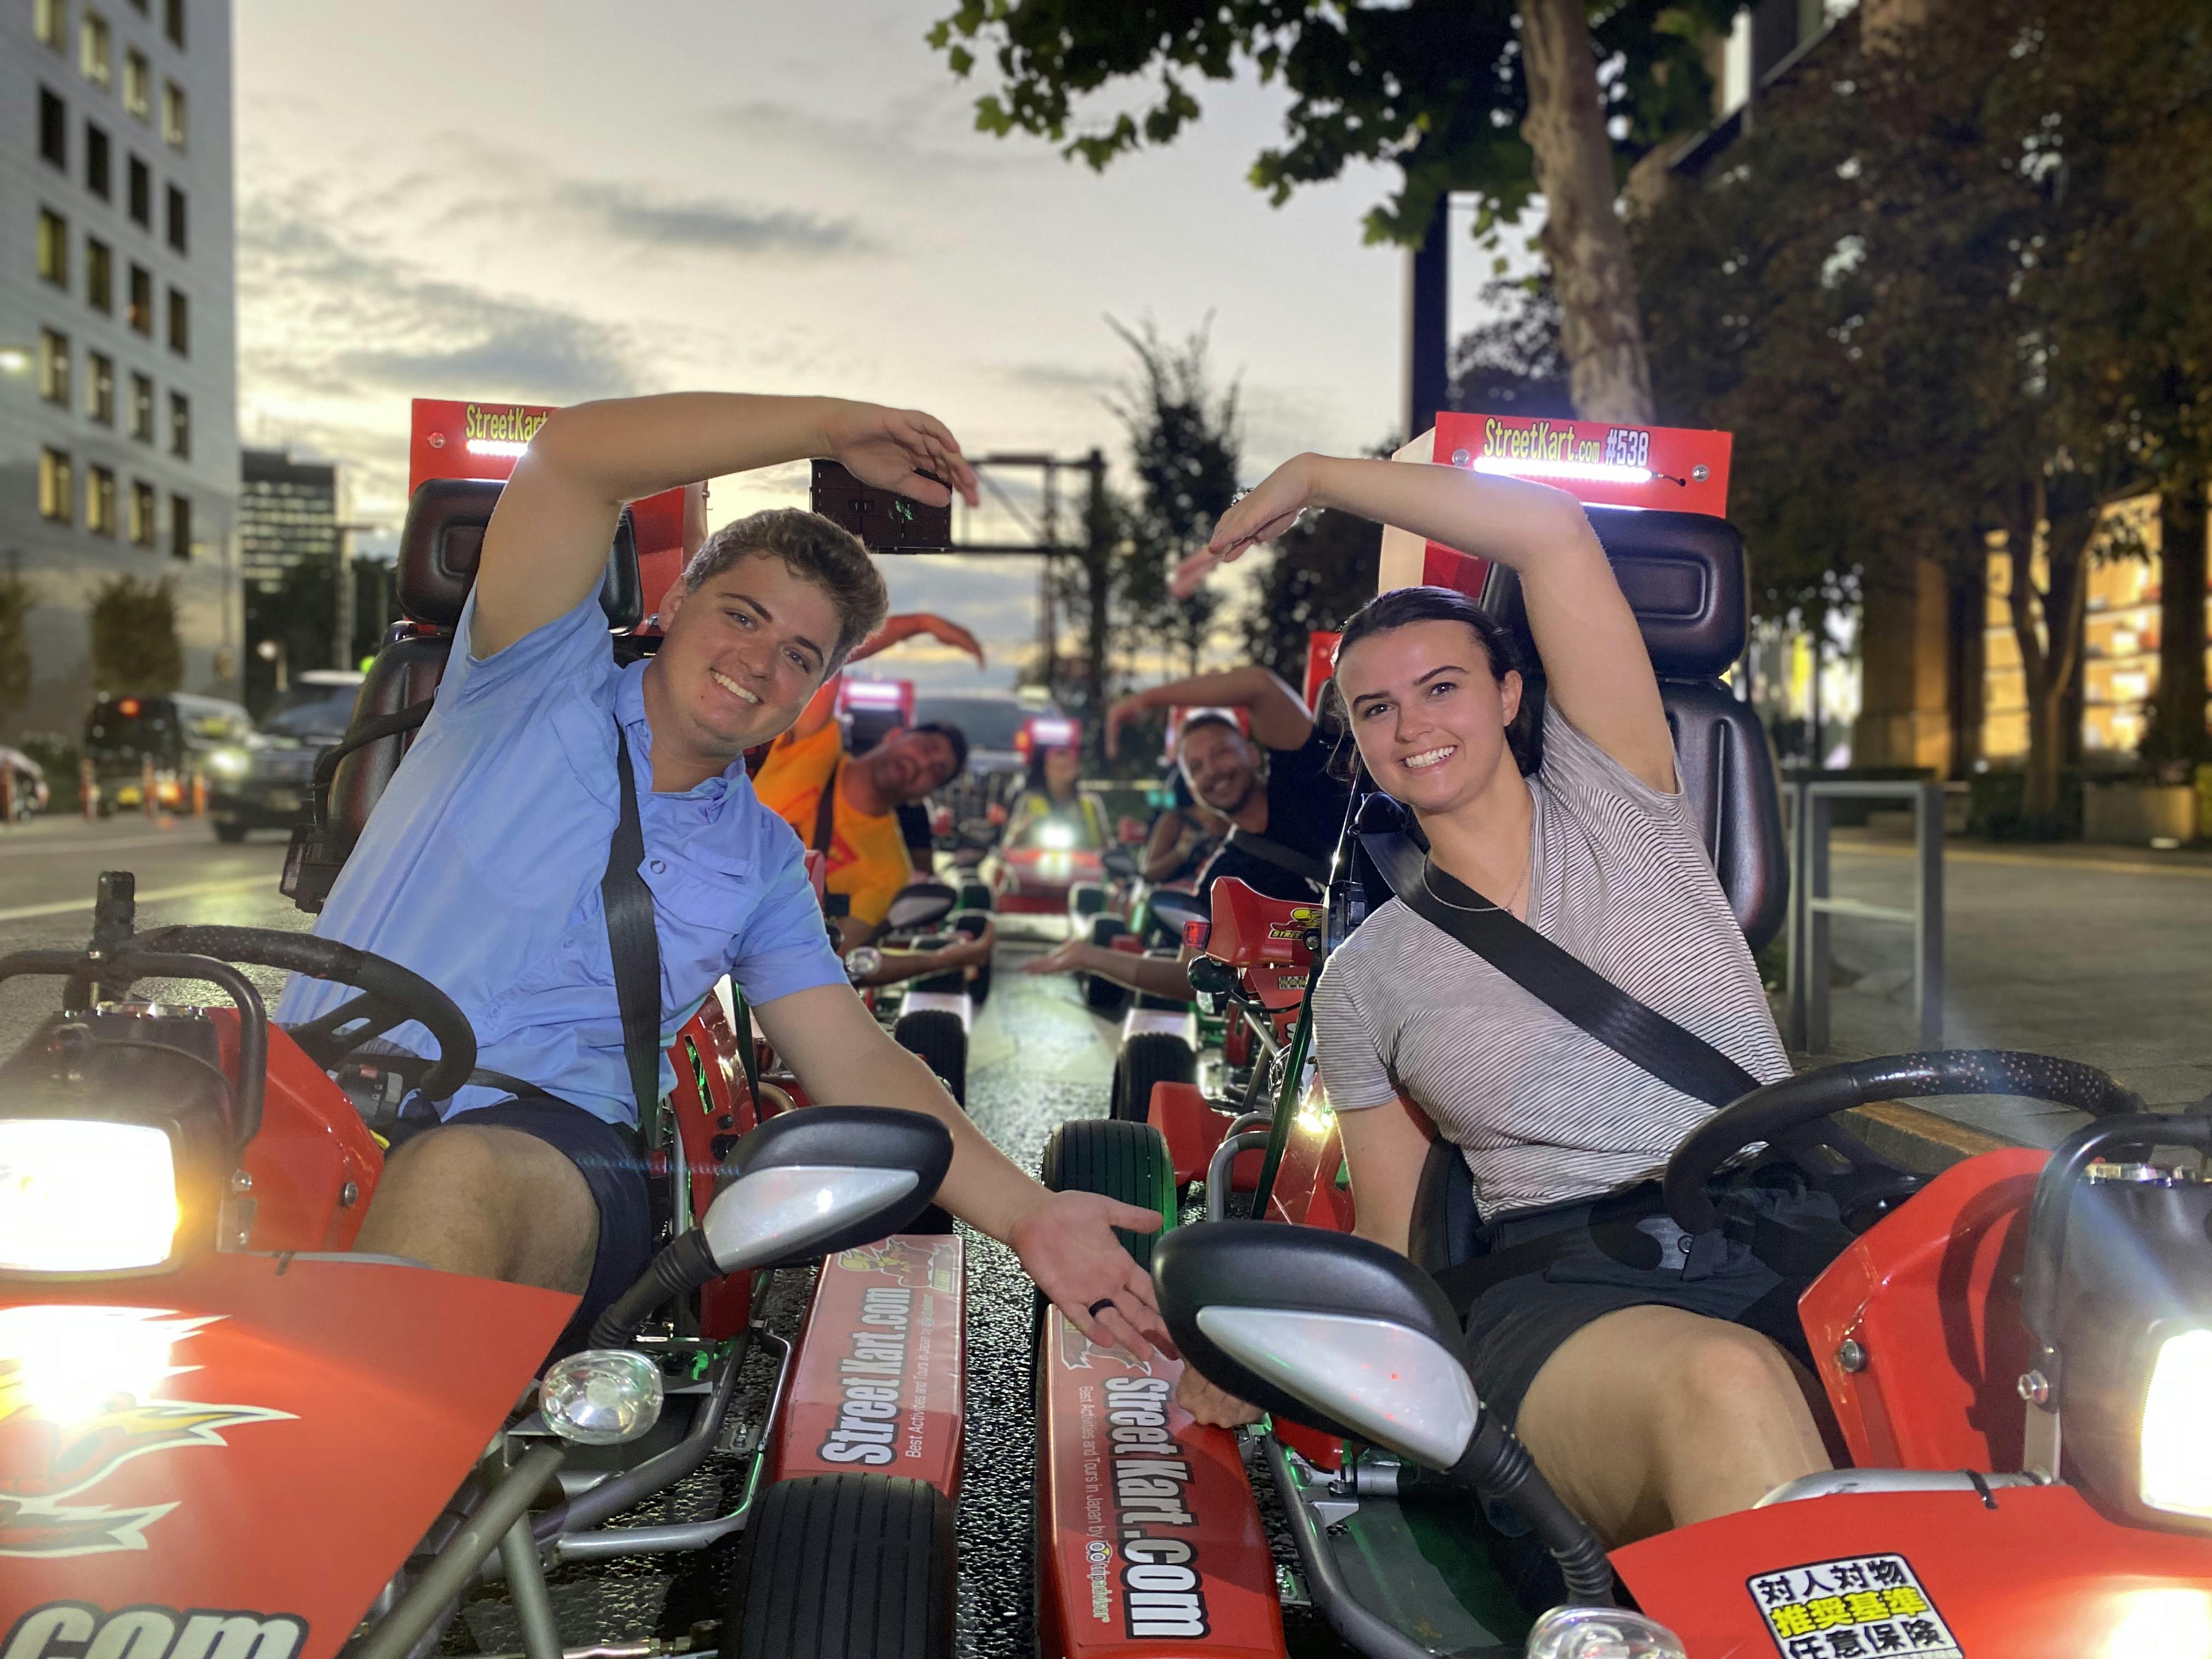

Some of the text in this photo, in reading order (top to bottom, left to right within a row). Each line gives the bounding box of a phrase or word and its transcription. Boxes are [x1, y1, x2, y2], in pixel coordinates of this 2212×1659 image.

[1483, 417, 1650, 466] StreetKart.com #538
[1273, 930, 1302, 938] STREE
[1079, 1386, 1094, 1403] Best
[908, 1395, 927, 1434] Activities
[1080, 1404, 1097, 1440] Activities
[905, 1435, 923, 1458] Best
[1083, 1441, 1099, 1455] and
[1084, 1457, 1101, 1482] Tours
[1086, 1484, 1102, 1493] in
[1084, 1495, 1104, 1523] Japan
[1087, 1526, 1106, 1538] by
[1758, 1560, 1908, 1604] 対人対物
[1771, 1587, 1929, 1638] 推奨基準
[1788, 1619, 1945, 1659] 任意保険
